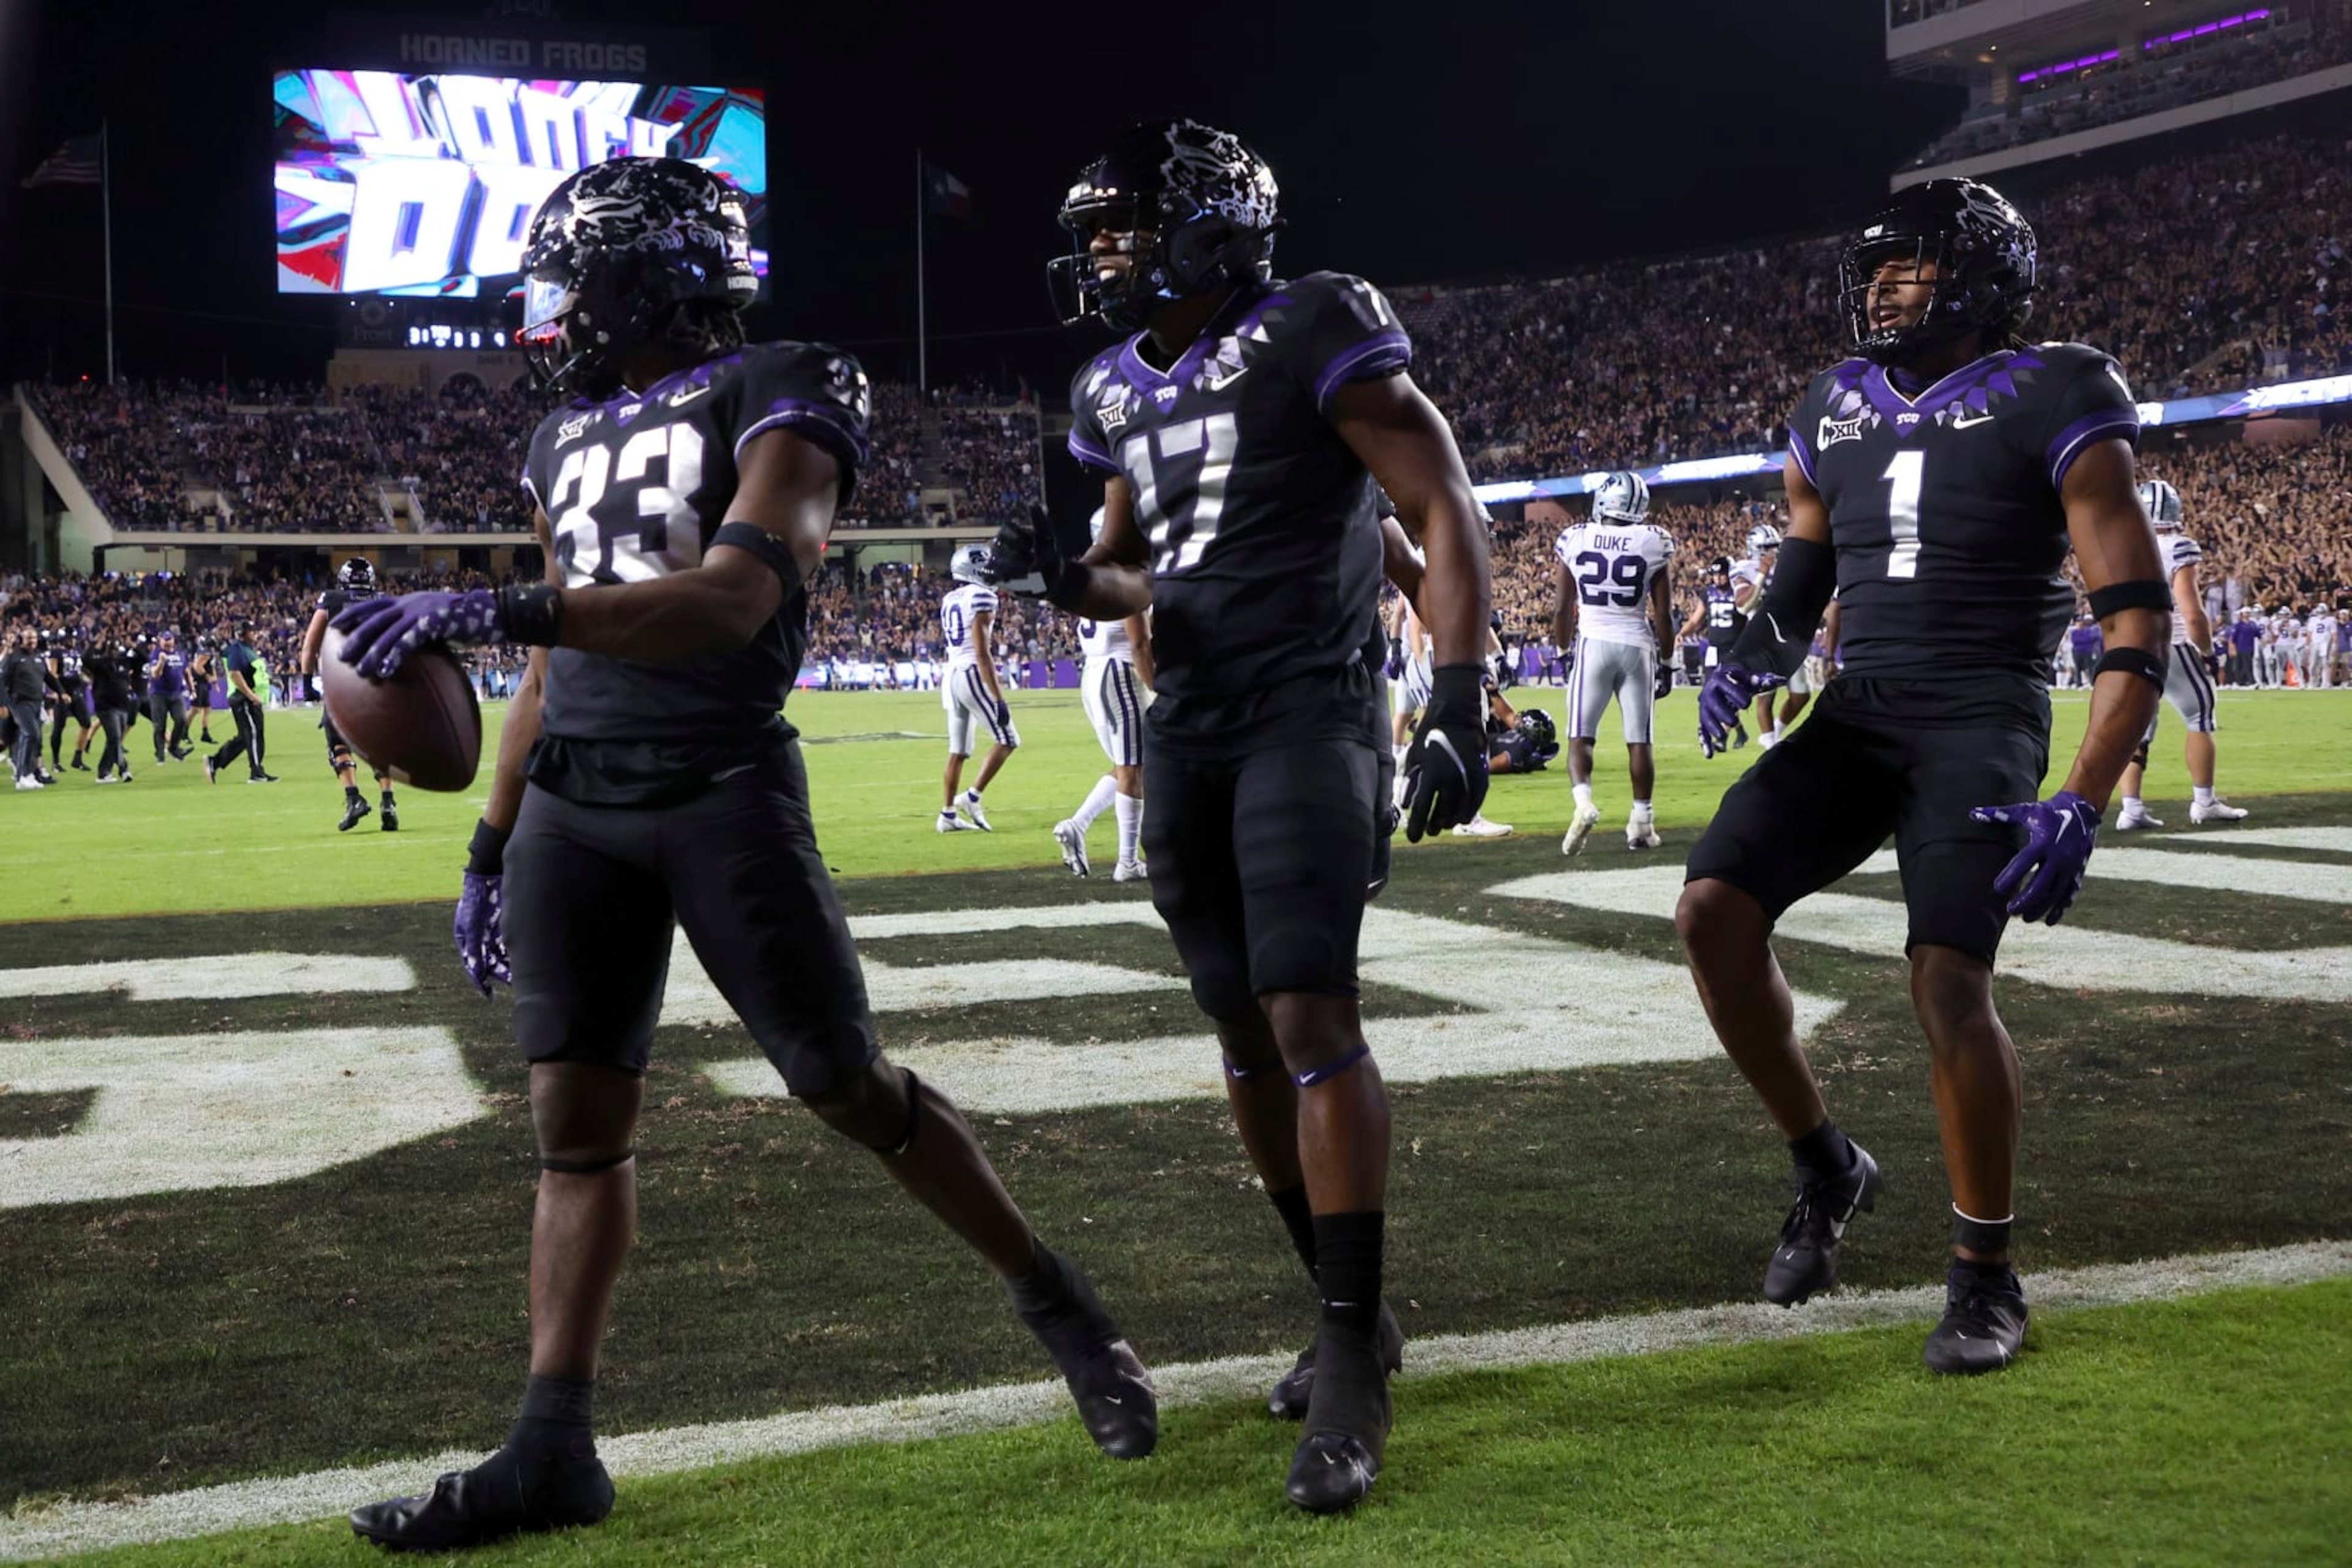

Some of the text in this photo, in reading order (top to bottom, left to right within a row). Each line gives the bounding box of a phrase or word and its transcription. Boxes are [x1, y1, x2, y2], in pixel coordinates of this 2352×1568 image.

[401, 33, 647, 72] HORNED FROGS
[1155, 385, 1178, 403] TCU
[1896, 412, 1921, 425] TCU
[1125, 412, 1238, 574] 17
[1883, 450, 1924, 578] 1
[1594, 534, 1632, 551] DUKE
[1576, 551, 1647, 606] 29
[1709, 602, 1734, 628] 15
